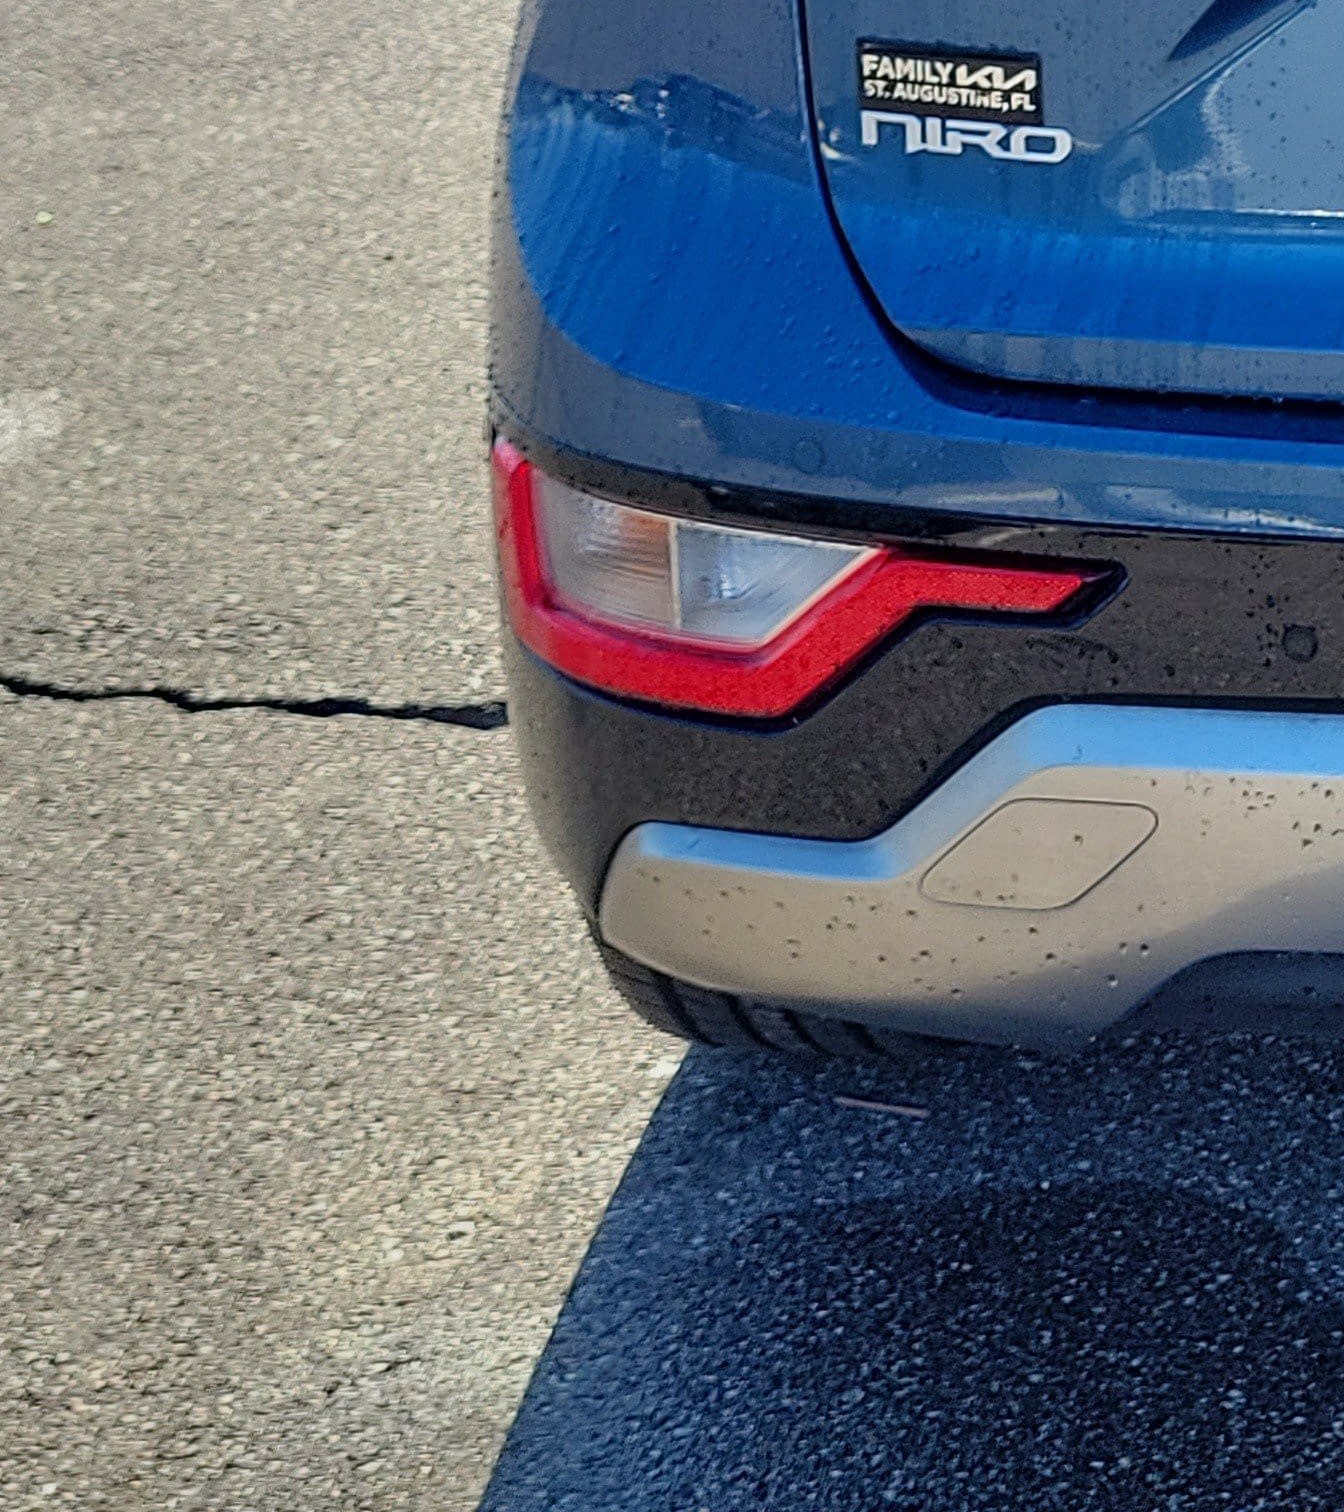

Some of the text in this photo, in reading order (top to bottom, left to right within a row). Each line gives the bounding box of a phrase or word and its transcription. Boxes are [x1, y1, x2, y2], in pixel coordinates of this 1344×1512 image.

[861, 53, 1037, 91] FAMILY KIA
[863, 81, 1037, 114] ST. AUGUSTINE, FL
